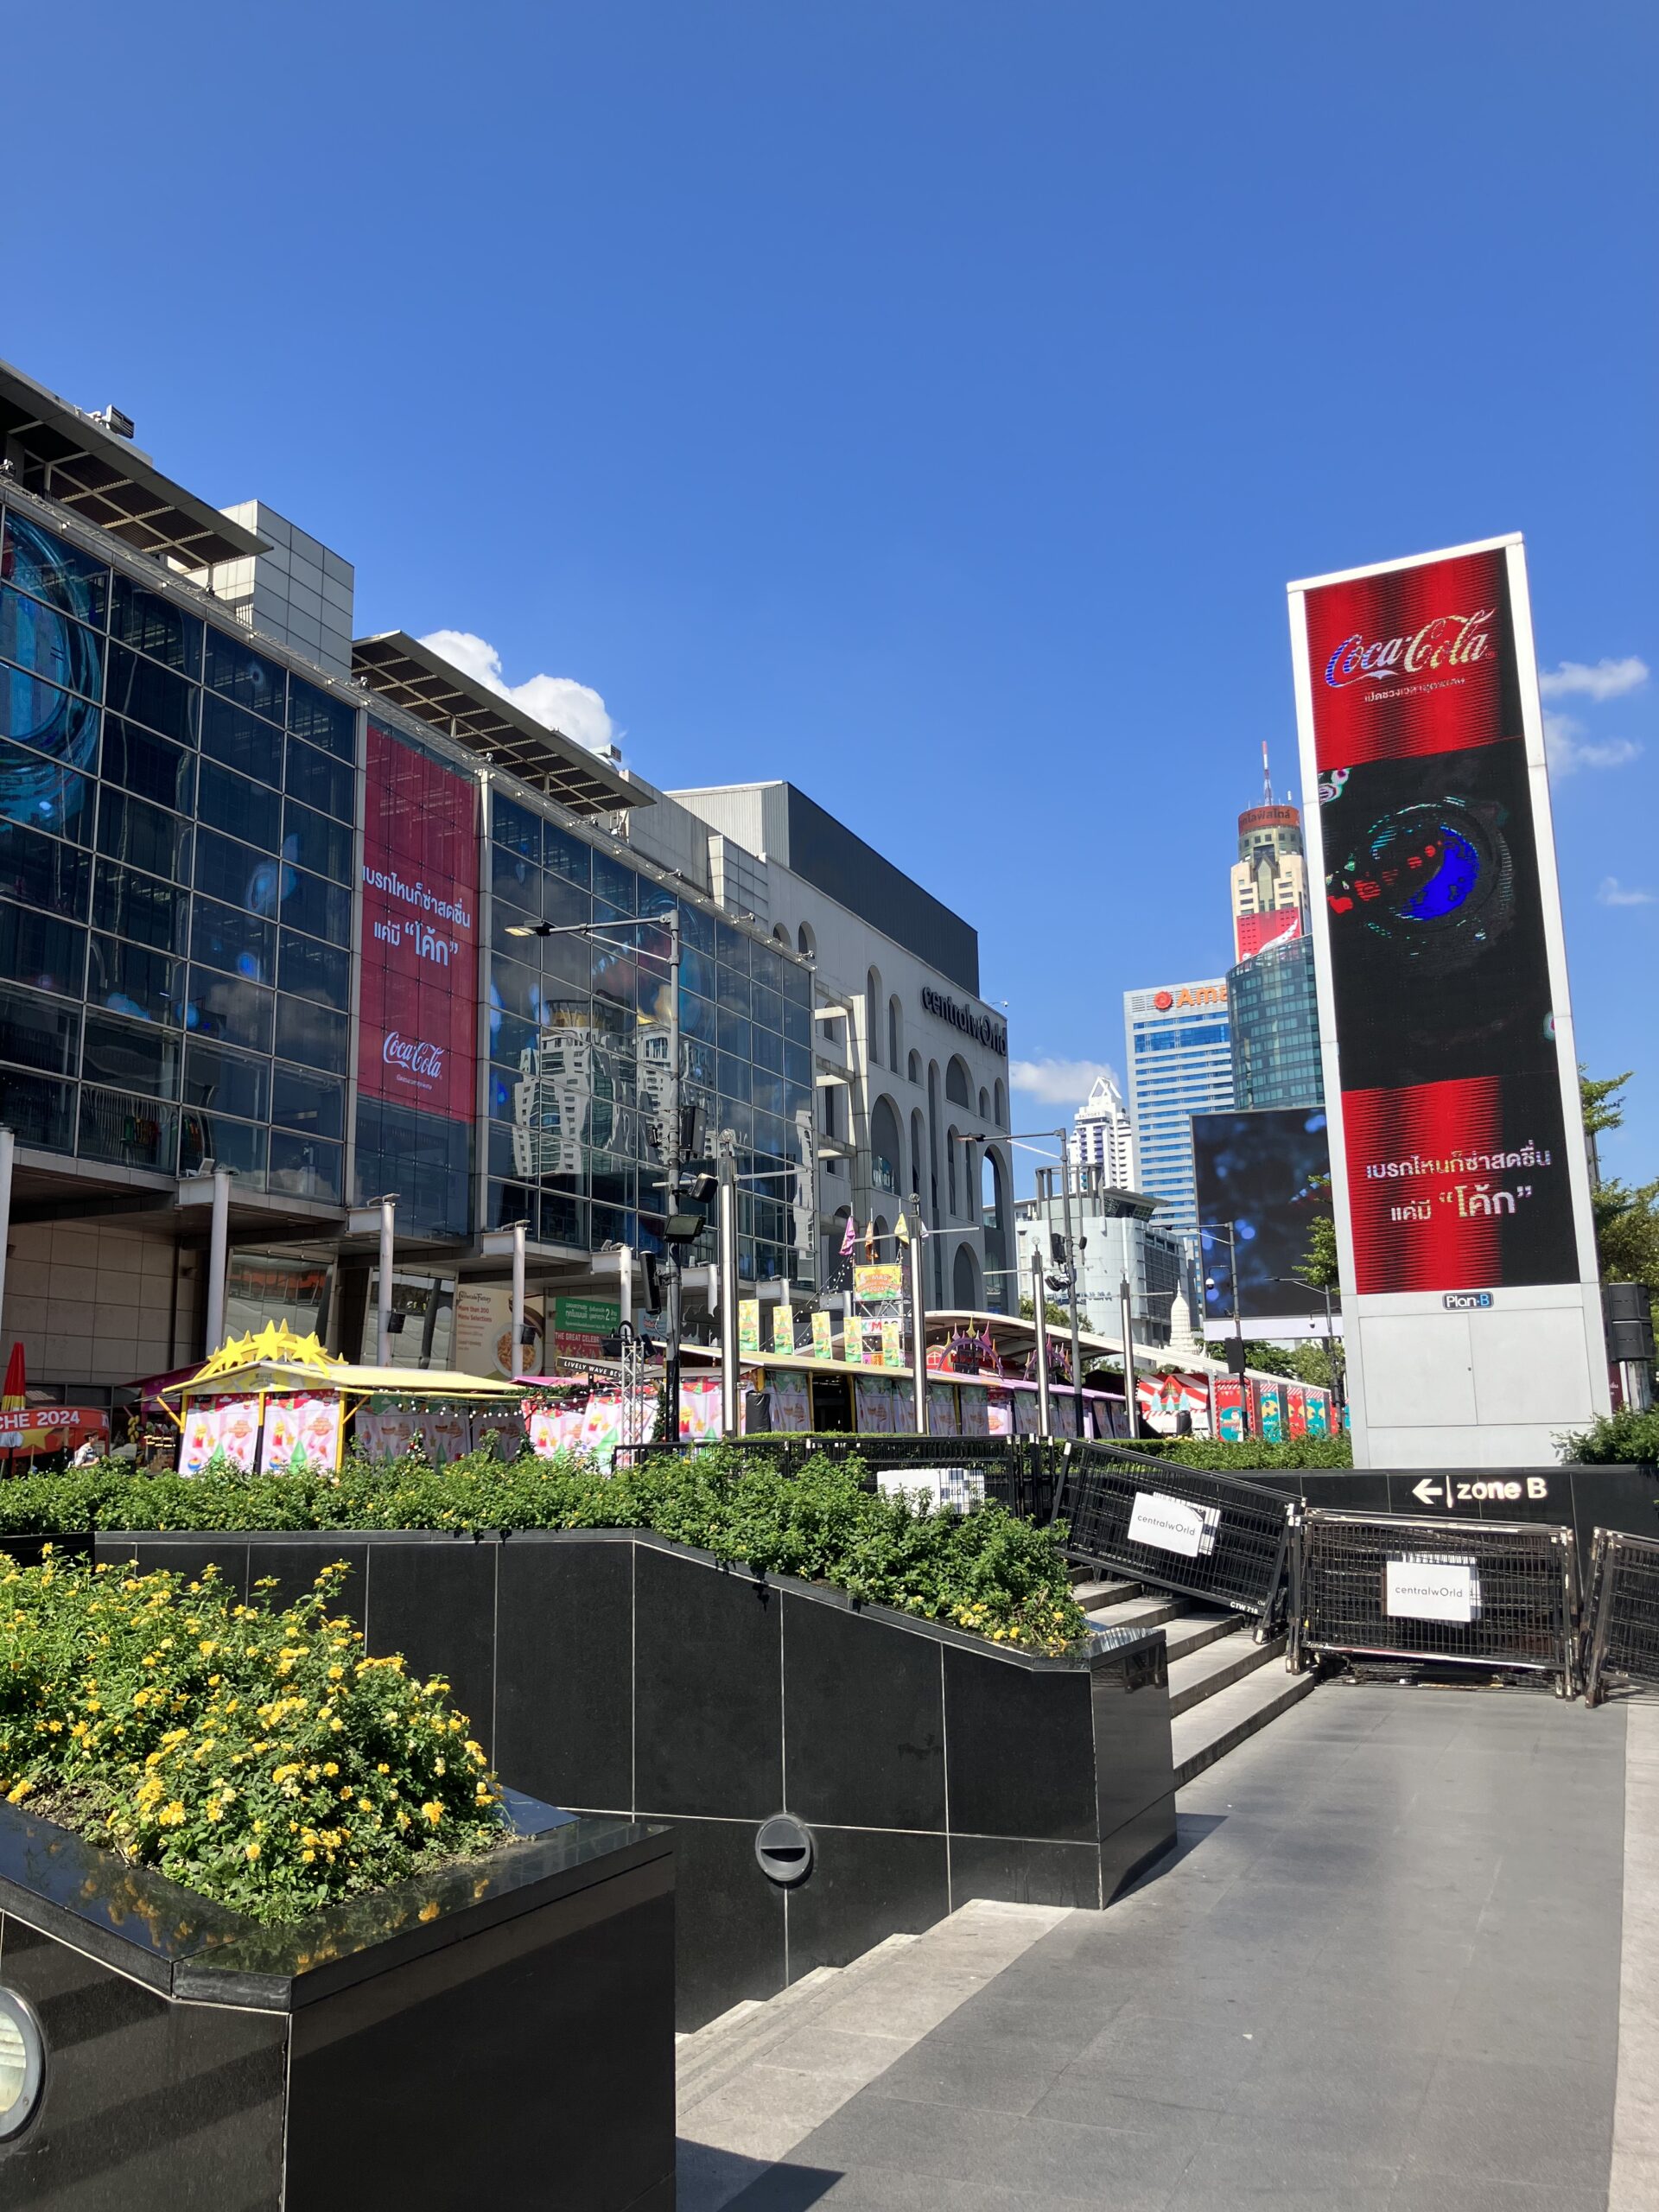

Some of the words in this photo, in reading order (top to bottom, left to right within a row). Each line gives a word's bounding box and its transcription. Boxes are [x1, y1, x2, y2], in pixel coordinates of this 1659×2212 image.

[362, 865, 471, 929] เบรกไหนก็ซ่าสดชื่น
[373, 920, 400, 946] แค่มี
[383, 1031, 445, 1078] Coca-Cola
[1366, 1139, 1552, 1179] เบรกไหนก็ซ่าสดชื่น
[1390, 1199, 1432, 1222] แค่มี
[605, 1309, 610, 1321] 2
[564, 1361, 587, 1370] LIVELY
[37, 1411, 80, 1426] 2024
[1457, 1482, 1522, 1500] zone
[1527, 1477, 1548, 1499] B
[1230, 1601, 1246, 1611] CTW
